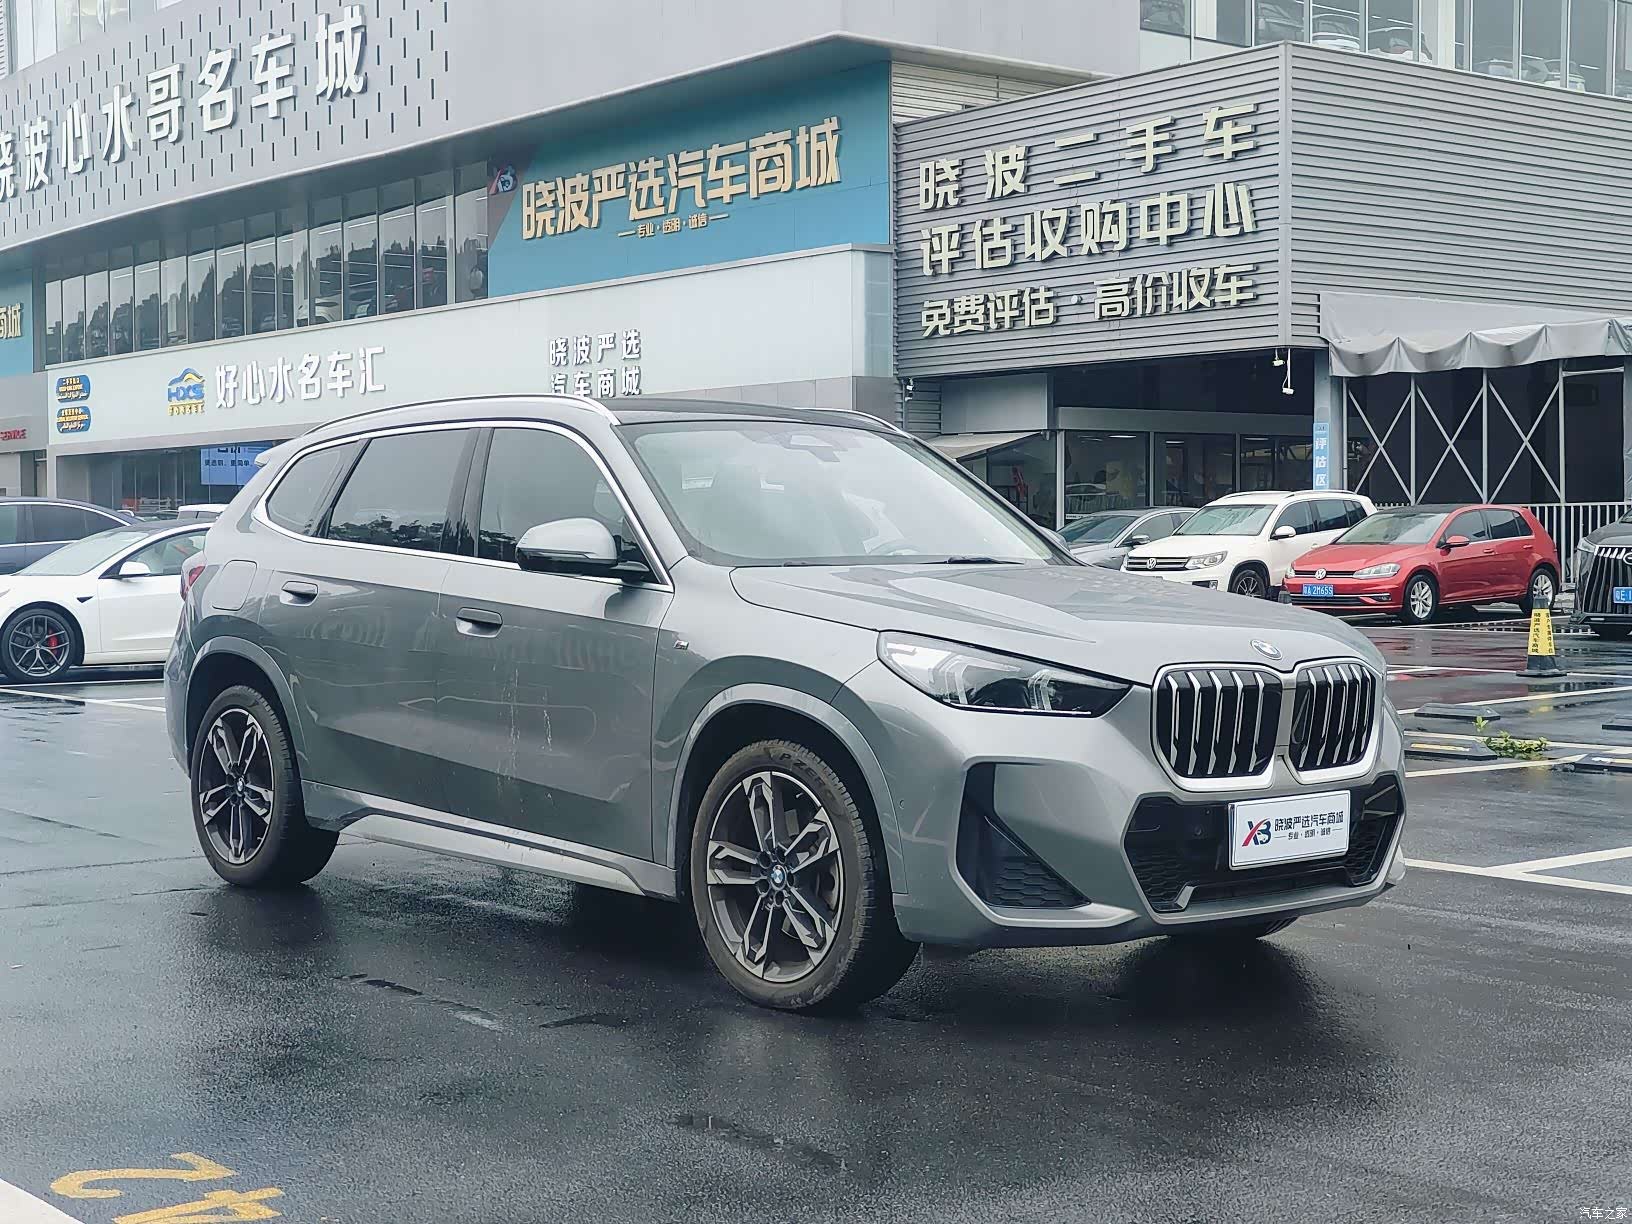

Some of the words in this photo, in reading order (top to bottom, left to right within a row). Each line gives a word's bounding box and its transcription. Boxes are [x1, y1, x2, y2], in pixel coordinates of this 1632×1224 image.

[522, 116, 841, 240] 晓波严选汽车商城
[919, 103, 1258, 210] 晓波二手车
[920, 182, 1257, 276] 评估收购中心
[549, 328, 641, 367] 晓波严选
[215, 346, 386, 408] 好心水名车汇
[551, 366, 641, 399] 汽车商城
[1315, 436, 1327, 487] 评估区
[1274, 811, 1344, 831] 晓波严选汽车商城
